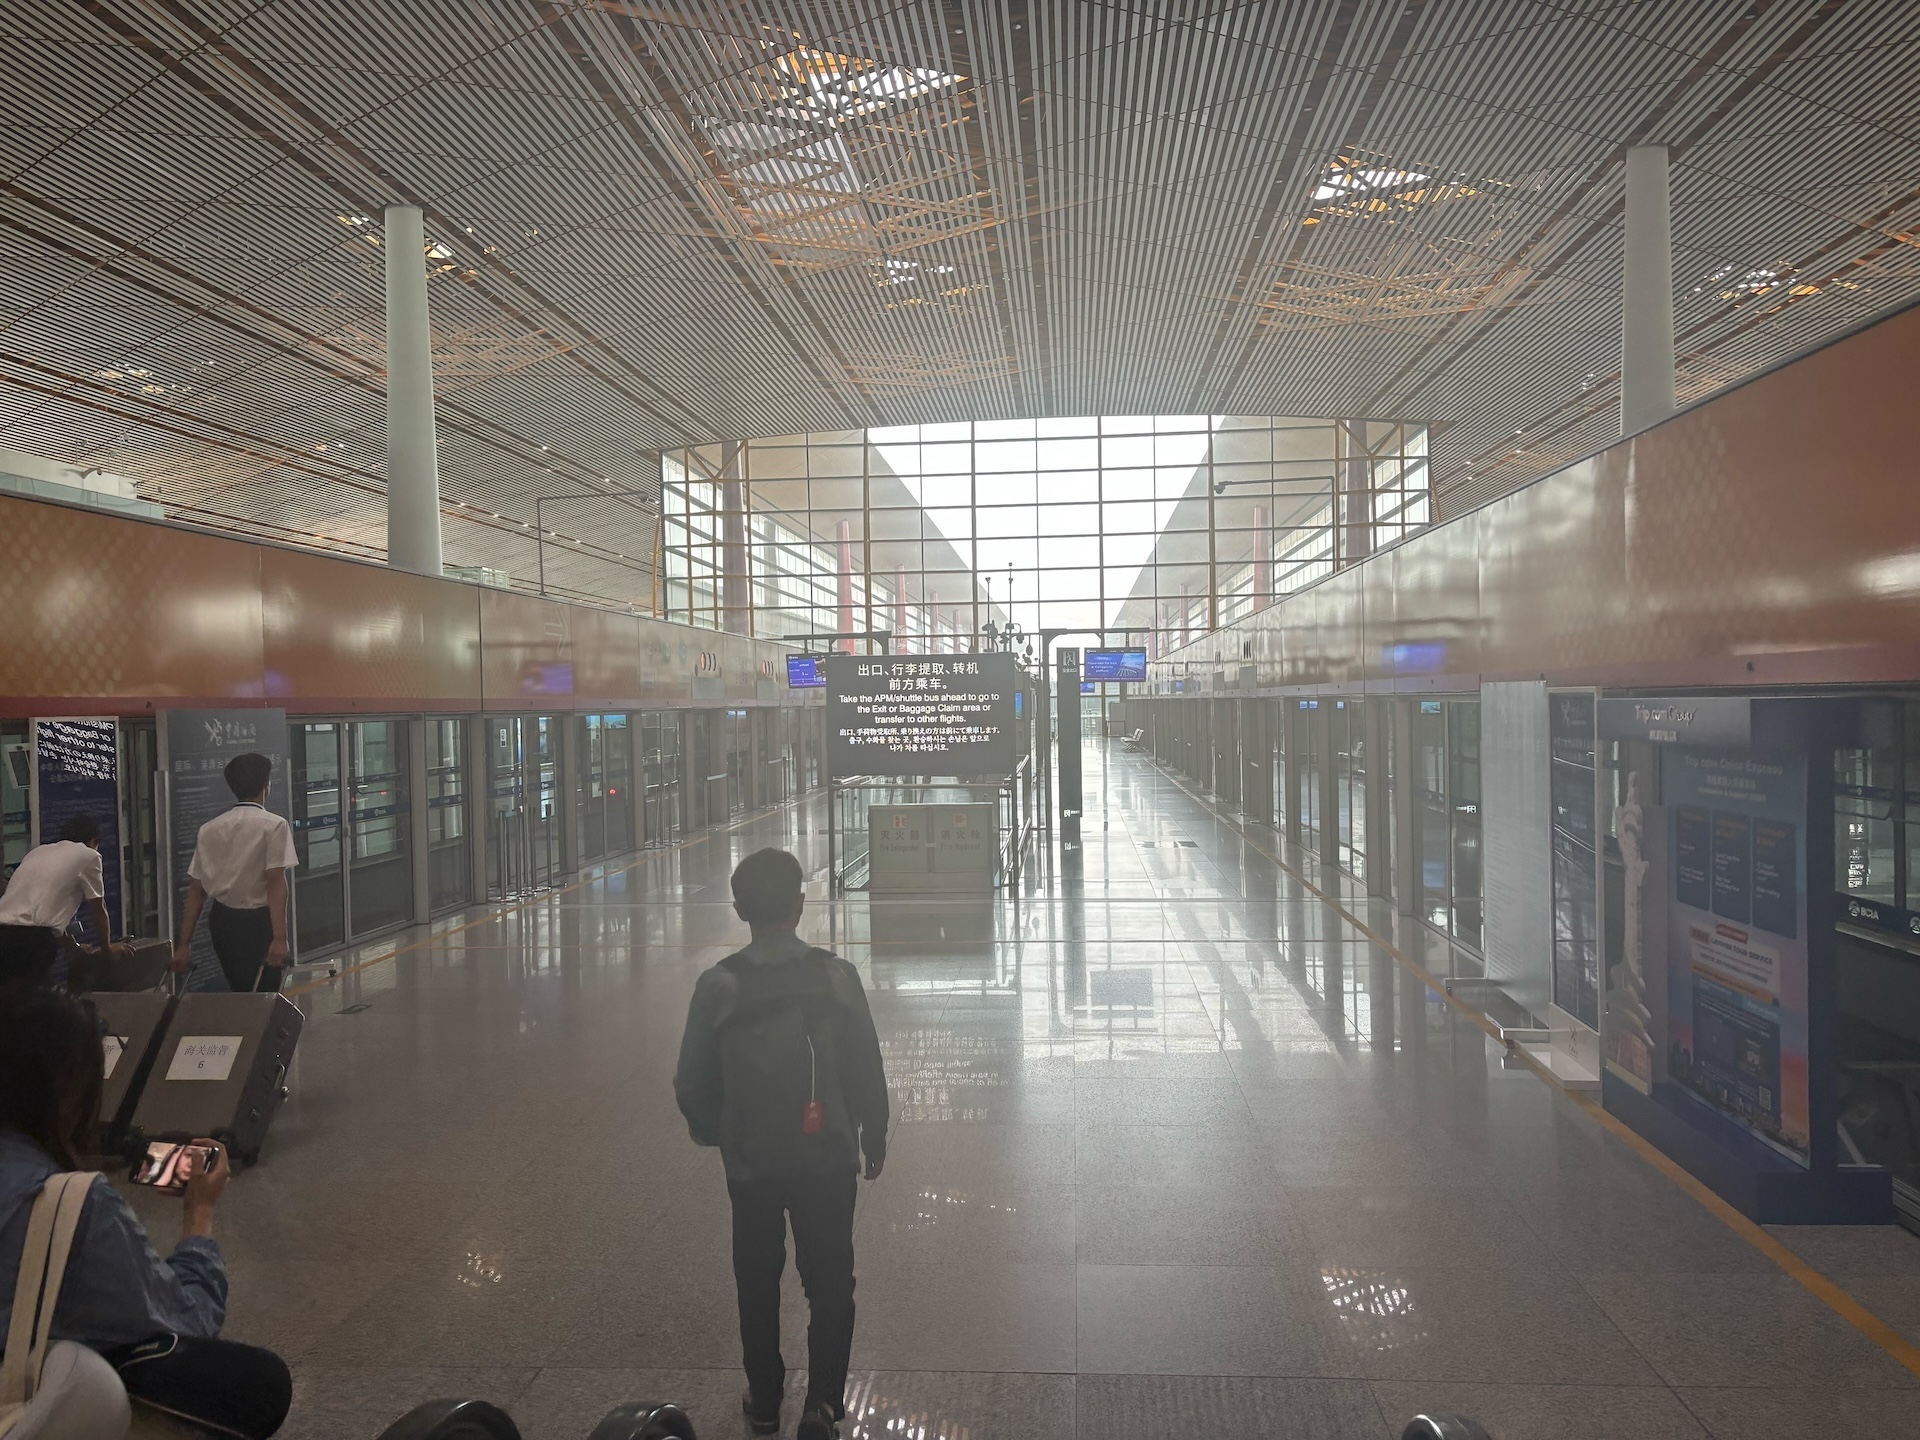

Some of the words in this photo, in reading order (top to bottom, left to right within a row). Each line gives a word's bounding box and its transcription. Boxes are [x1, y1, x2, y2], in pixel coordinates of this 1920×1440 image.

[858, 662, 979, 676] 出口、行李提取、转机
[889, 677, 948, 690] 前方乘车。
[839, 694, 858, 703] Take
[860, 694, 872, 702] the
[874, 694, 922, 702] APM/shuttle
[978, 694, 989, 702] go
[900, 704, 936, 714] Baggage
[940, 714, 966, 724] flights.
[198, 1060, 205, 1068] 6
